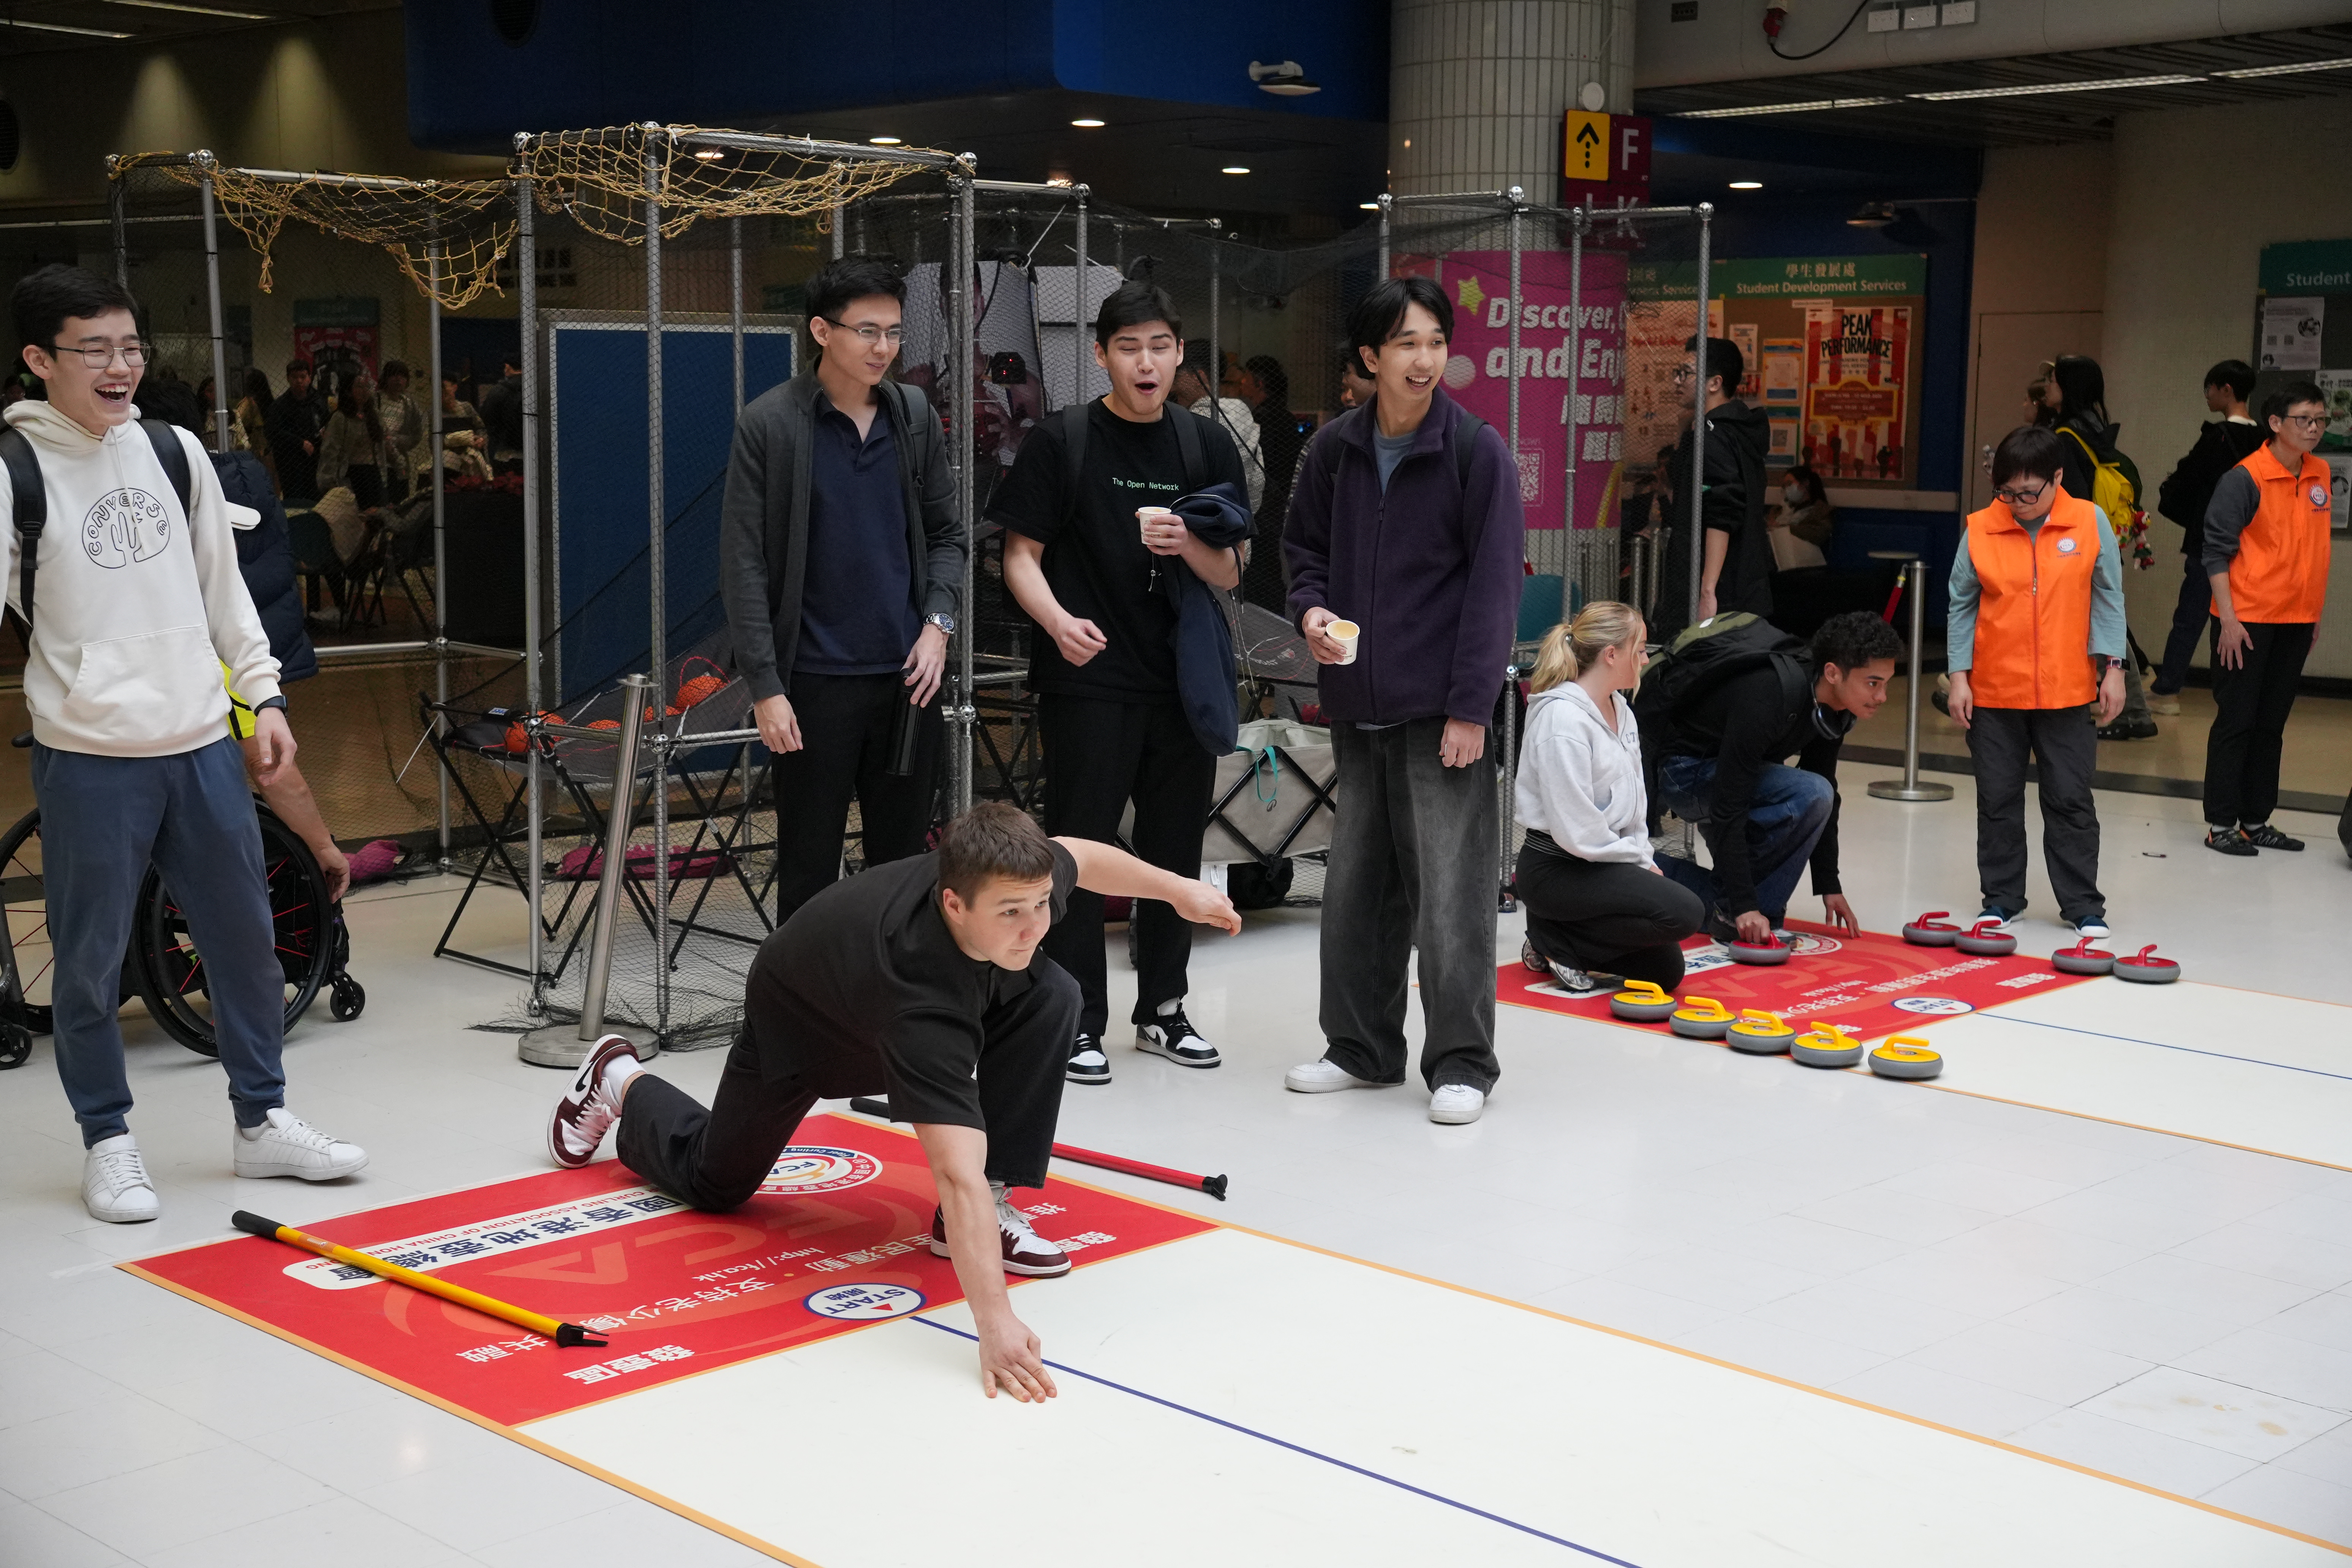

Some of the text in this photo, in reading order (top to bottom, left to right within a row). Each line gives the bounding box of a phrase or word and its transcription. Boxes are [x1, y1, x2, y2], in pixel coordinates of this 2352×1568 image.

[1622, 128, 1639, 171] F
[1617, 195, 1639, 239] K
[1737, 279, 1906, 294] Student Development Services
[2286, 271, 2352, 286] Student
[1486, 297, 1615, 334] Discover,
[1842, 314, 1873, 336] PEAK
[1821, 337, 1893, 357] PERFORMANCE
[1485, 336, 1626, 387] and Enj
[1112, 477, 1179, 491] The Open Network
[88, 492, 168, 556] CONVERSE
[582, 1192, 645, 1207] CURLING
[482, 1205, 578, 1230] ASSOCIATION
[367, 1245, 405, 1256] HON
[405, 1234, 456, 1247] CHINA
[306, 1258, 343, 1270] ONG
[691, 1246, 825, 1282] http://fca.hk
[822, 1287, 869, 1301] 開始
[824, 1288, 907, 1315] START
[562, 1345, 695, 1385] 發壺區
